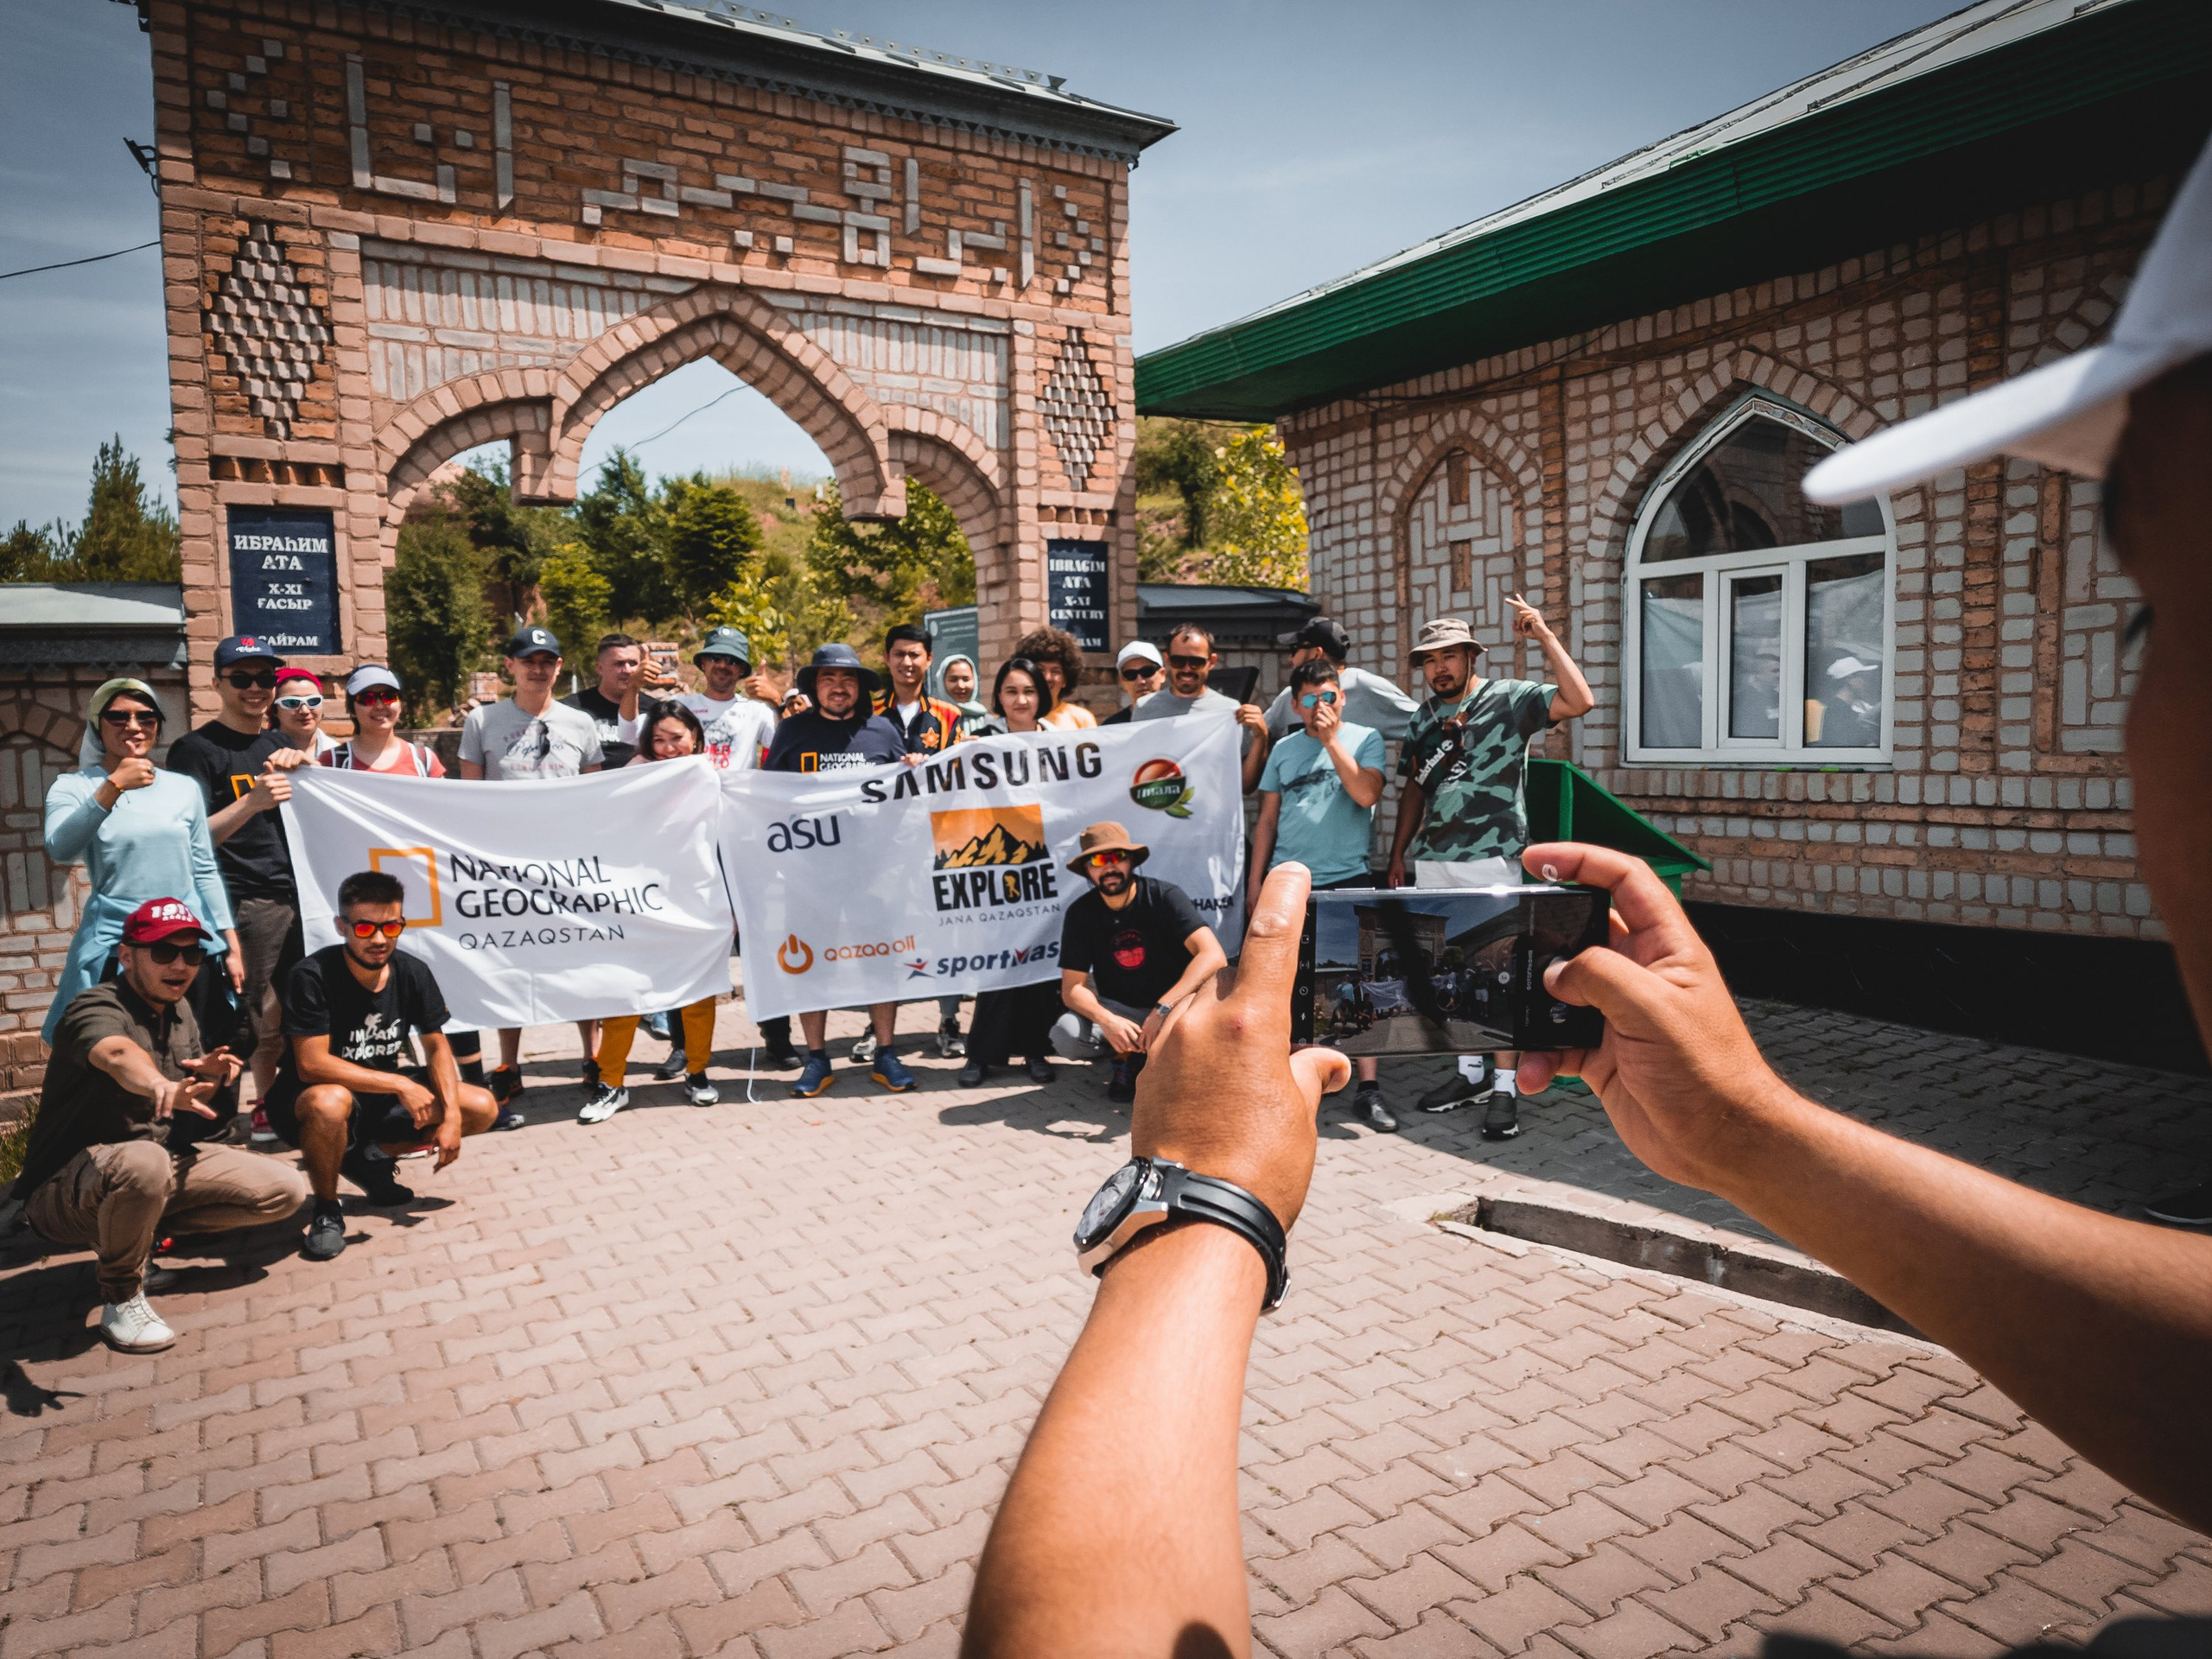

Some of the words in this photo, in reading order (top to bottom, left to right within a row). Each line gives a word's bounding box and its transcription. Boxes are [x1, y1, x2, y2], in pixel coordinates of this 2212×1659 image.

[262, 555, 302, 570] АТА
[1049, 559, 1105, 572] IBRAGIM
[1063, 576, 1091, 588] ATA
[1065, 595, 1090, 606] X-XI
[1051, 609, 1105, 620] CENTURY
[531, 630, 546, 645] C
[819, 753, 866, 763] NATIONAL
[861, 742, 1103, 804] SAMSUNG
[450, 854, 611, 887] NATIONAL
[932, 862, 1058, 912] EXPLORE
[454, 883, 664, 918] GEOGRAPHIC
[938, 914, 974, 927] JANA
[979, 904, 1061, 922] QAZAQSTAN
[459, 925, 625, 950] QAZAQSTAN
